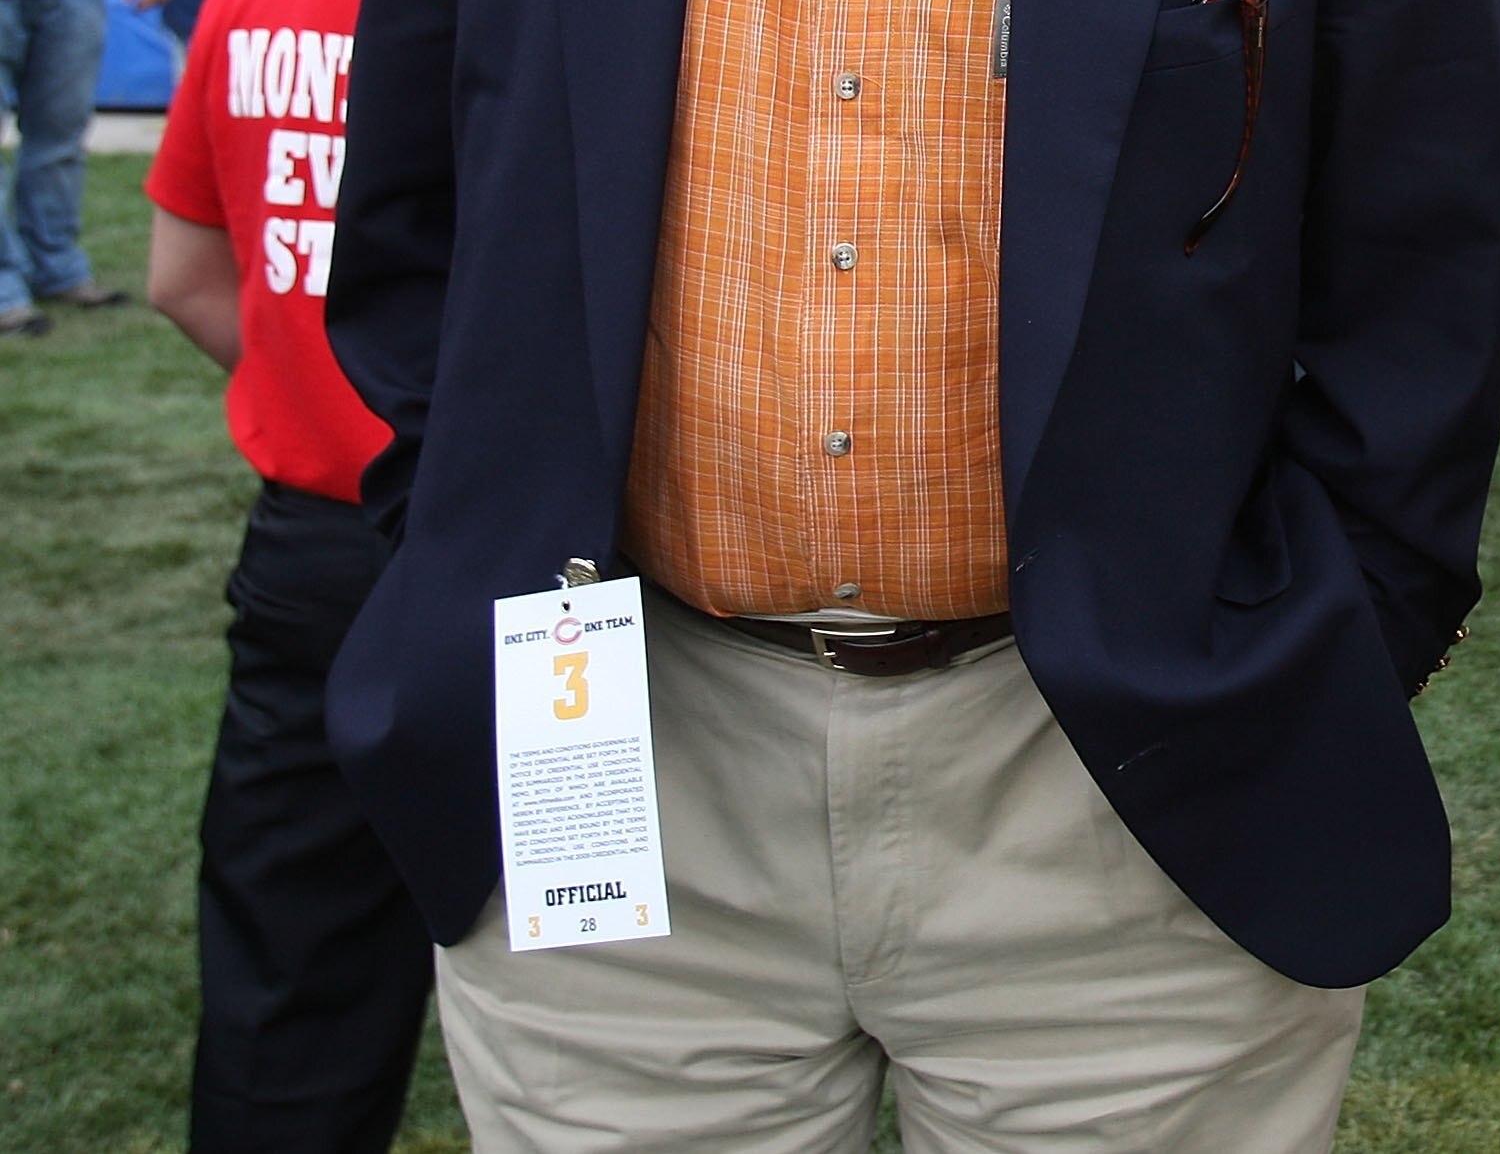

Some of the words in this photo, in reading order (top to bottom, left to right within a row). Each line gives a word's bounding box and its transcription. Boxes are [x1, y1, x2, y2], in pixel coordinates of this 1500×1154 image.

[264, 128, 346, 209] EV
[264, 216, 336, 296] ST
[504, 633, 523, 645] ONE
[584, 621, 604, 633] ONE
[606, 616, 635, 629] TEAM.
[553, 651, 589, 720] 3
[545, 880, 627, 907] OFFICIAL
[528, 916, 541, 938] 3
[580, 917, 598, 933] 28
[635, 904, 648, 926] 3
